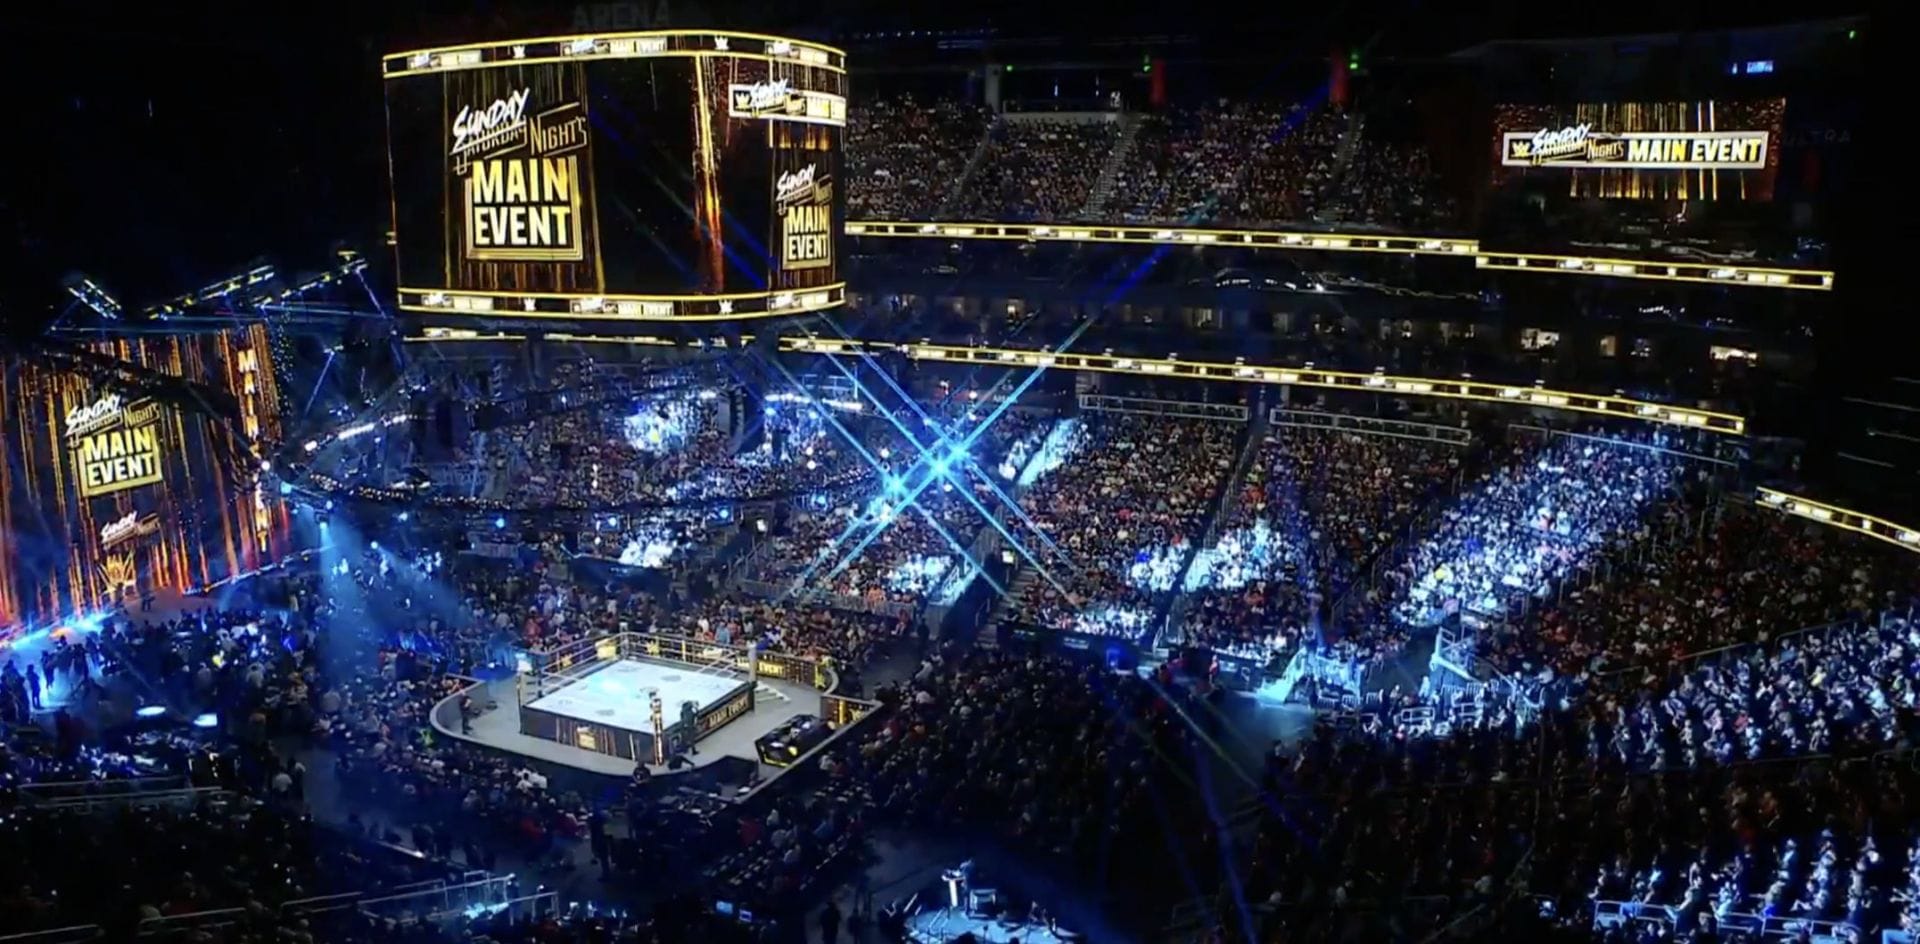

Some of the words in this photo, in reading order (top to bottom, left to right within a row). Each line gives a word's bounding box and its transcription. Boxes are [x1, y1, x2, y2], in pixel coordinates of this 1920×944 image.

[572, 1, 670, 28] ARENA
[453, 87, 530, 153] SUNDAY
[1530, 123, 1592, 154] SUNDAY
[1628, 139, 1688, 162] MAIN
[1690, 138, 1762, 162] EVENT
[472, 158, 569, 203] MAIN
[776, 162, 816, 201] SUNDAY
[474, 206, 570, 245] EVENT
[788, 206, 830, 233] MAIN
[787, 234, 829, 260] EVENT
[64, 392, 121, 437] SUNDAY
[84, 427, 153, 463] MAIN
[238, 349, 260, 441] MAIN
[249, 441, 269, 553] EENT
[87, 453, 154, 487] EVENT
